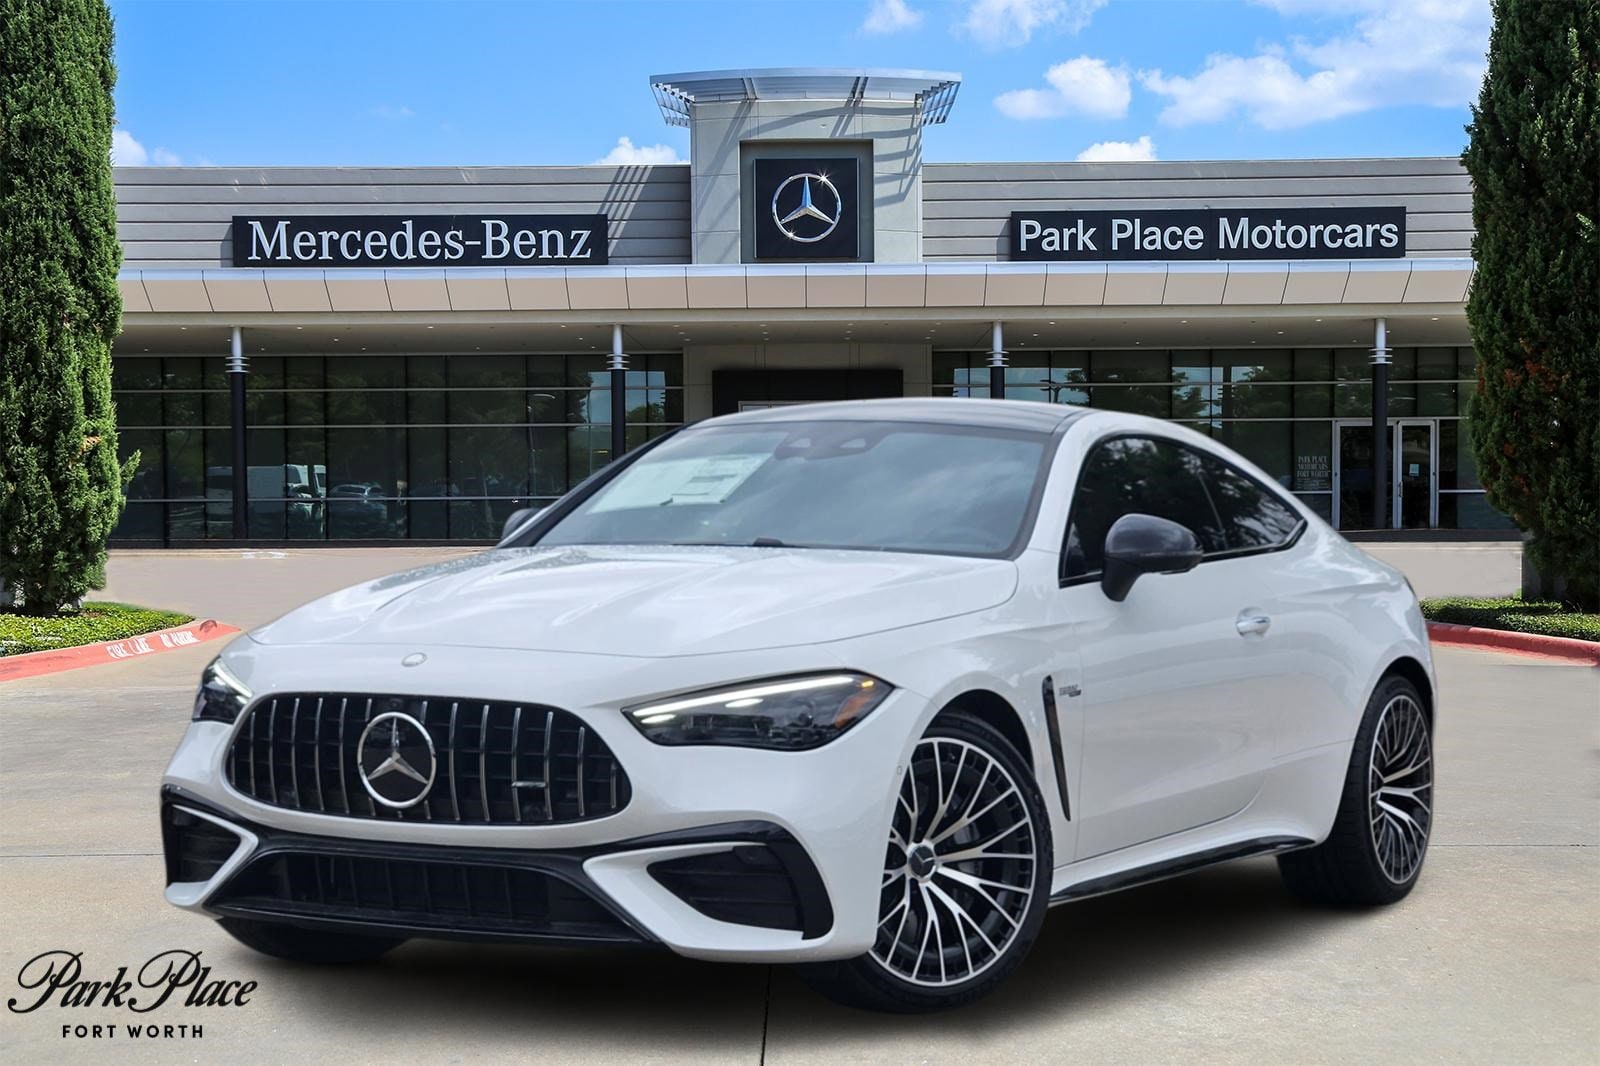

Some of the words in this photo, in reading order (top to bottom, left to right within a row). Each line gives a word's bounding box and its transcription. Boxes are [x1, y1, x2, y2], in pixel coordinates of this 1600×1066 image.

[247, 219, 592, 261] Mercedes-Benz
[1019, 219, 1097, 251] Park
[1111, 219, 1203, 251] Place
[1218, 217, 1399, 249] Motorcars
